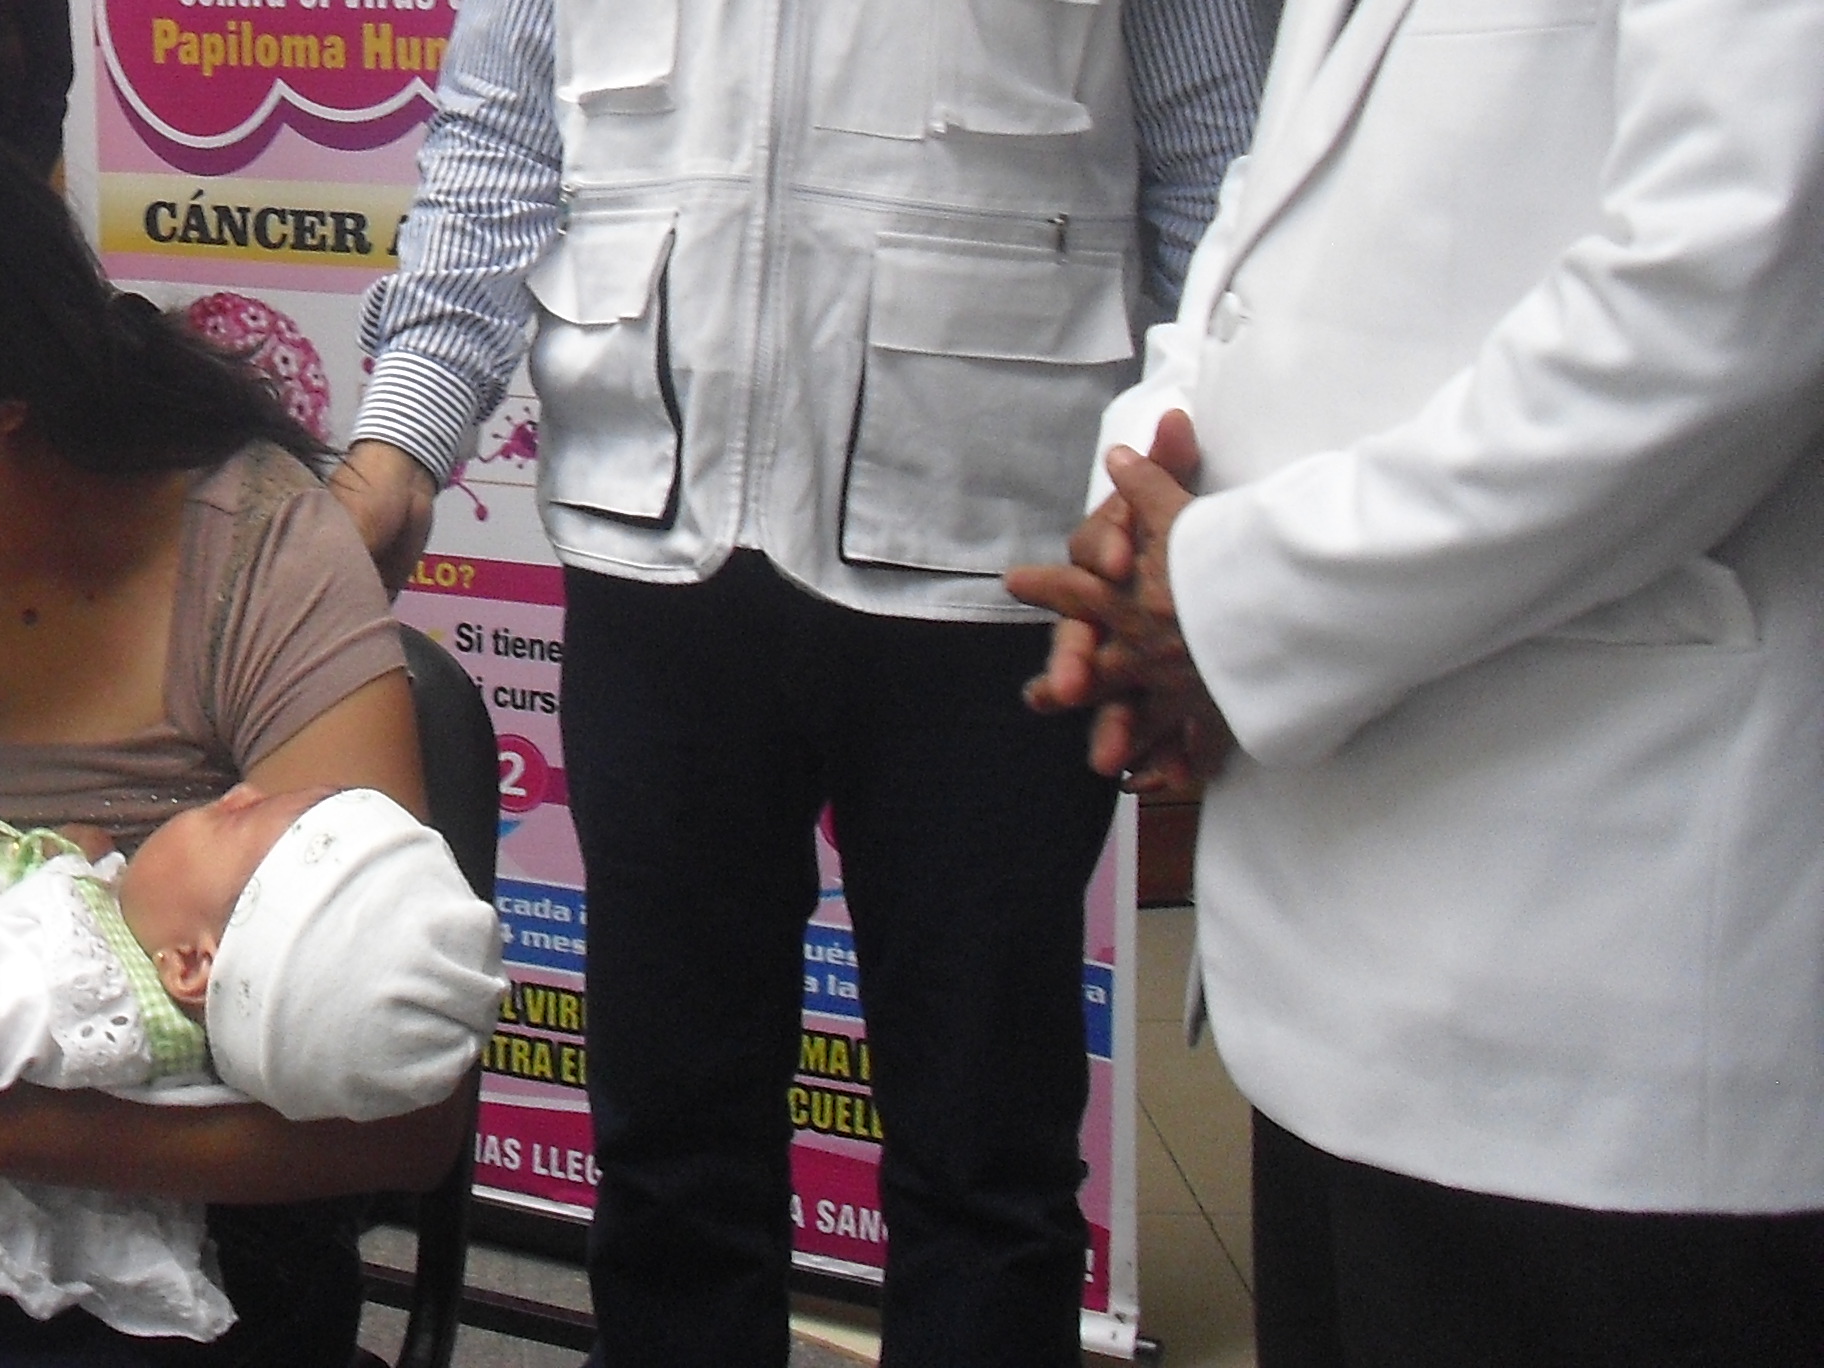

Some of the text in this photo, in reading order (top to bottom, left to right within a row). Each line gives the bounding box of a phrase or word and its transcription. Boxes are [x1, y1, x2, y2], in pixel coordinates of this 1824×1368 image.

[152, 18, 347, 77] Papiloma
[145, 189, 373, 256] CÁNCER
[455, 622, 484, 654] Si
[497, 750, 528, 797] 2
[496, 894, 572, 924] cada
